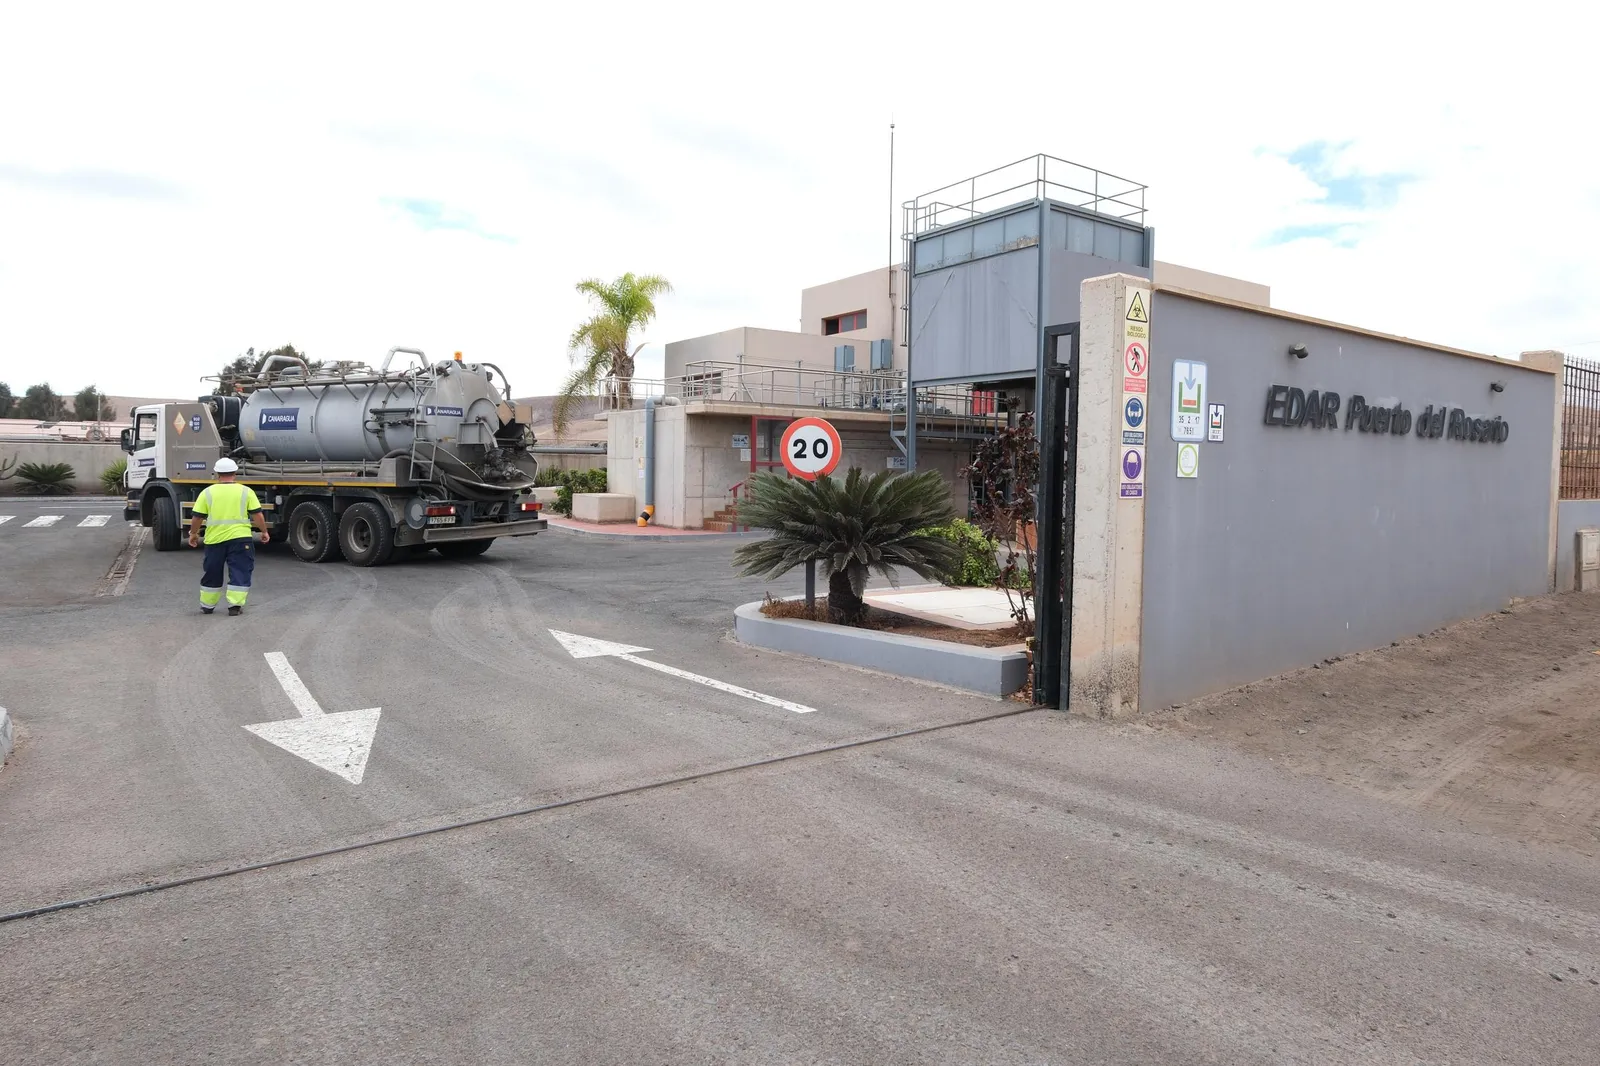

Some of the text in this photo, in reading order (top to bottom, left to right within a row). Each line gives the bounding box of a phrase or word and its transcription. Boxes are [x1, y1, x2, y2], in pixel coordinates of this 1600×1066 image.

[1264, 384, 1509, 443] EDAR Puerto del Rosario
[793, 438, 829, 459] 20
